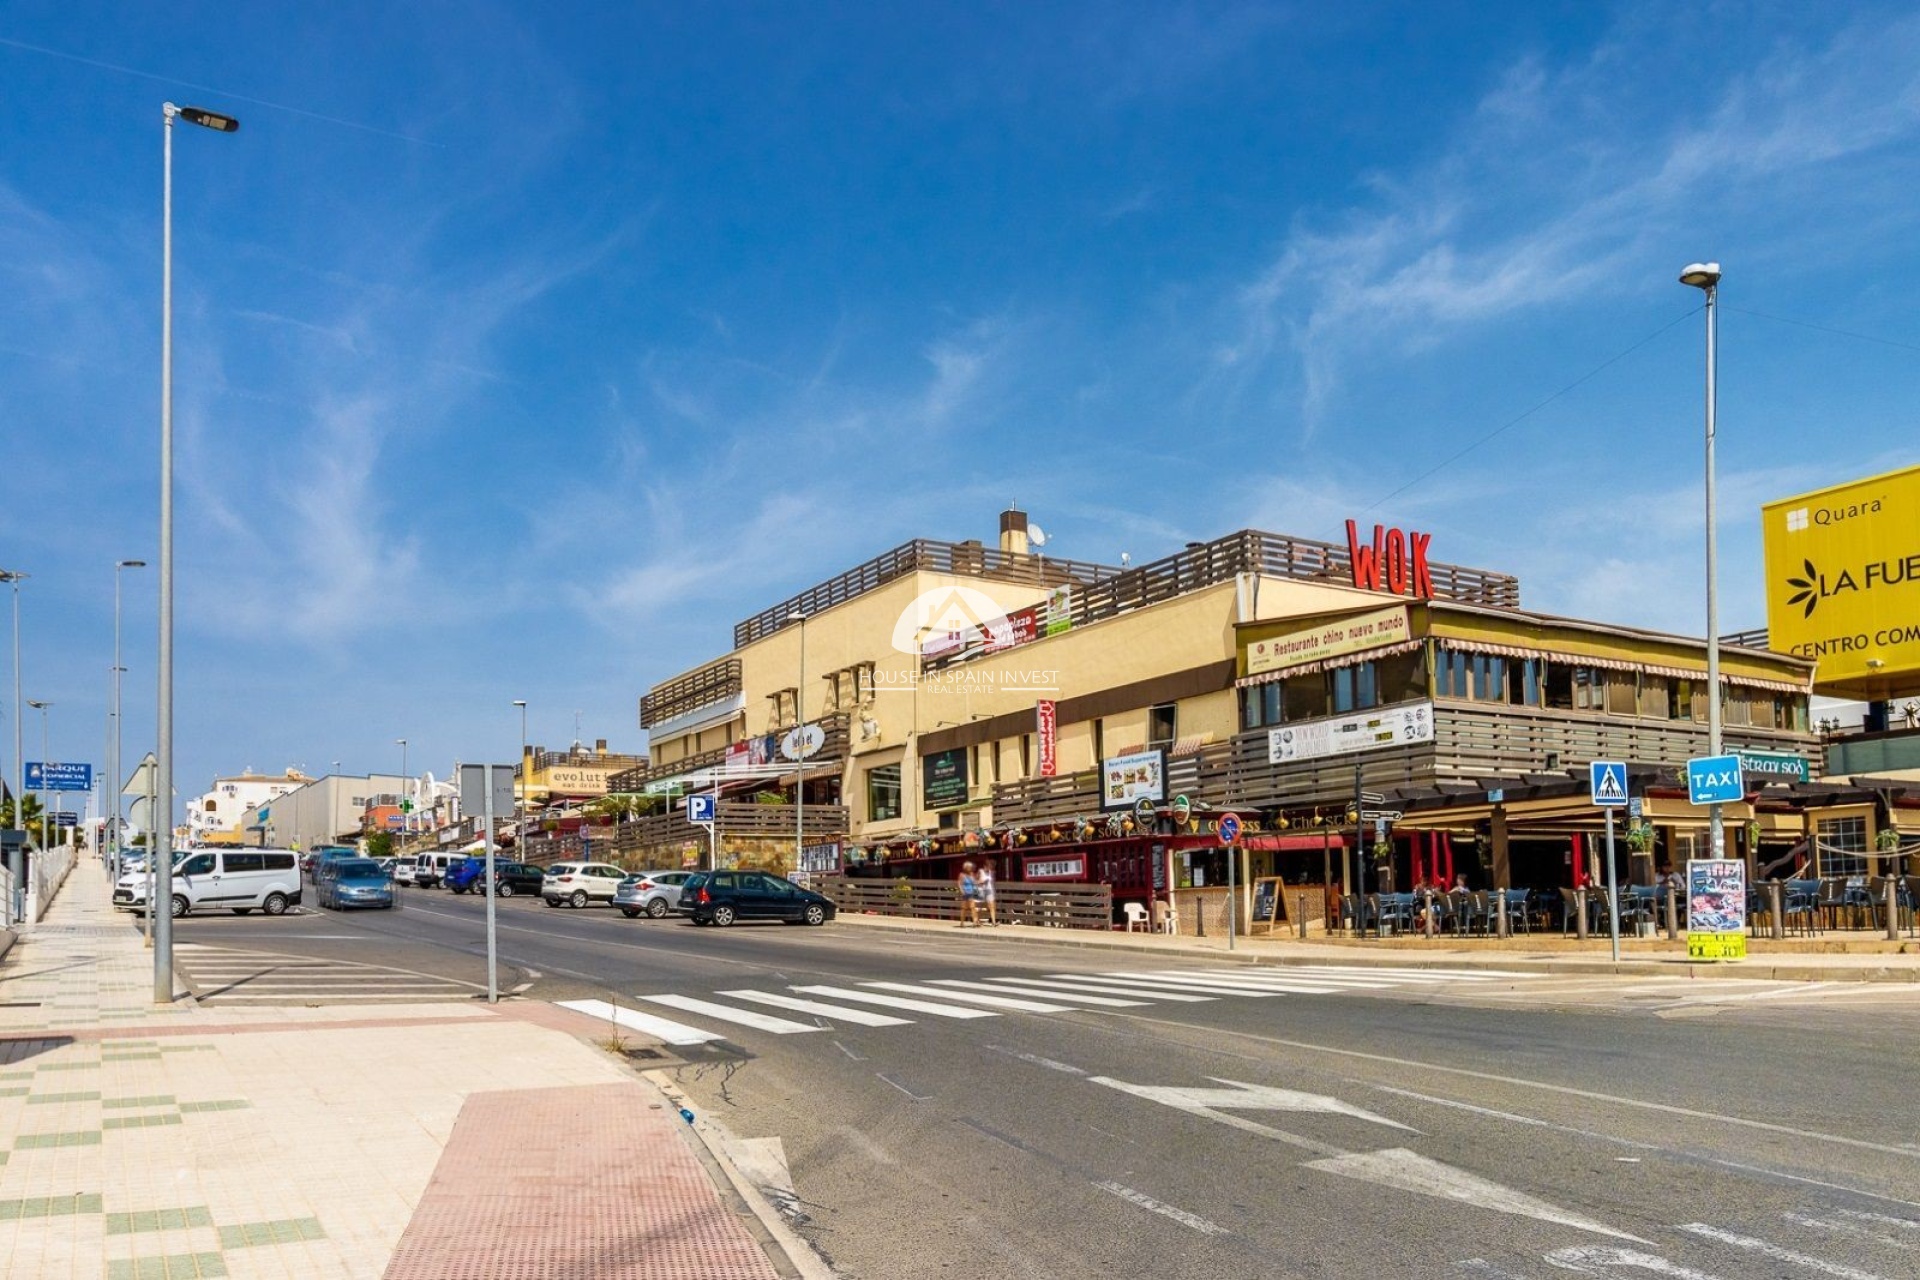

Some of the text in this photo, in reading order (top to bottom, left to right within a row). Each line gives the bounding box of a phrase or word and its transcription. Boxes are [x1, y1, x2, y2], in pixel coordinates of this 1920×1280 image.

[1814, 499, 1882, 526] Quara
[1345, 518, 1435, 600] WOK
[1819, 554, 1920, 598] LA FUE
[1273, 634, 1319, 656] Restaurante
[1323, 629, 1344, 644] chino
[1349, 624, 1374, 639] nuevo
[1378, 614, 1404, 632] mundo
[1790, 633, 1868, 657] CENTRO
[553, 771, 608, 782] evoluti
[1691, 771, 1739, 788] TAXI
[690, 797, 707, 820] P
